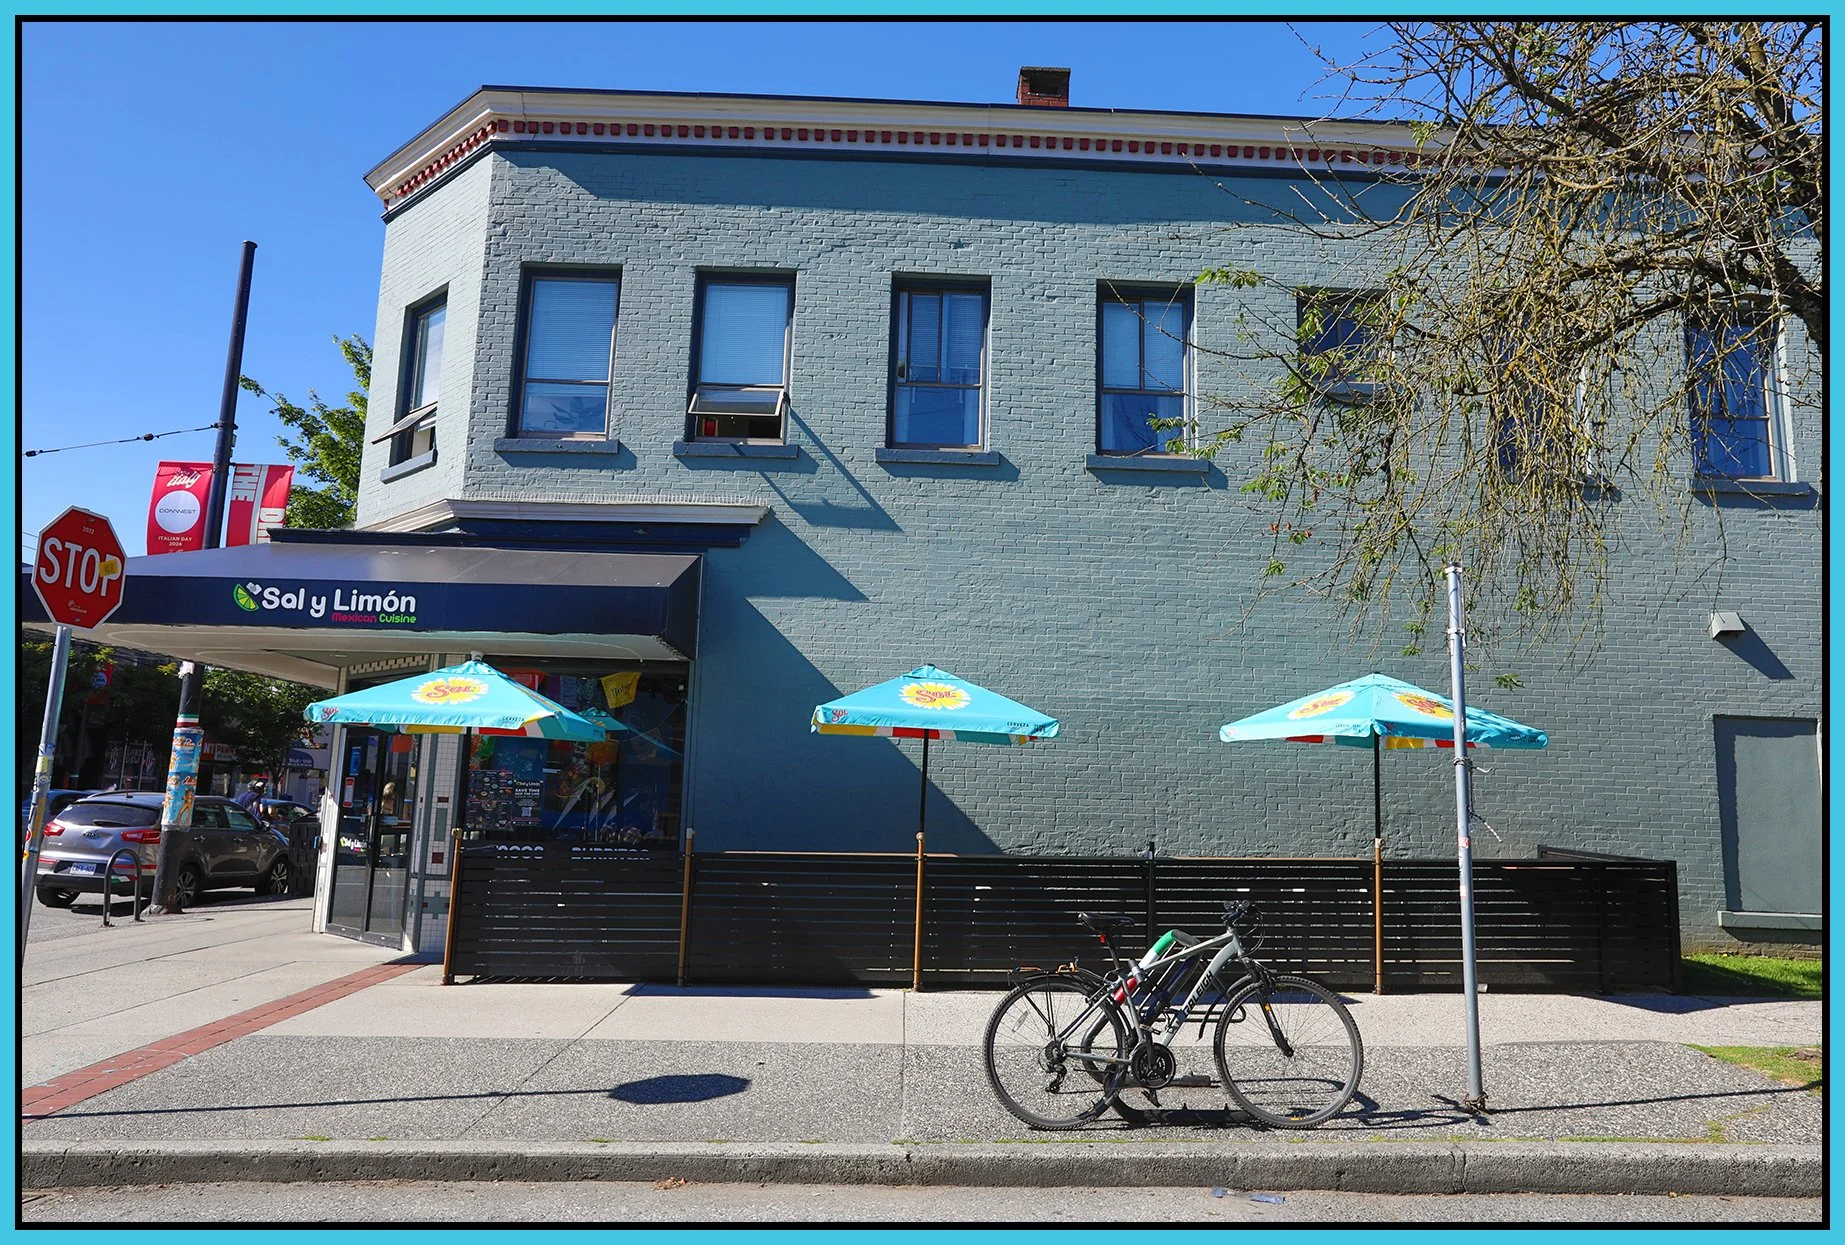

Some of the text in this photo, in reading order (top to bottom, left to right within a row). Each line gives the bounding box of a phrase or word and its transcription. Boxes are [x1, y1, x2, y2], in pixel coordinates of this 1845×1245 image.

[82, 526, 95, 535] 2022
[39, 536, 122, 597] STOP
[261, 586, 416, 618] Sal y Limón
[331, 612, 417, 624] Mexican Cuisine
